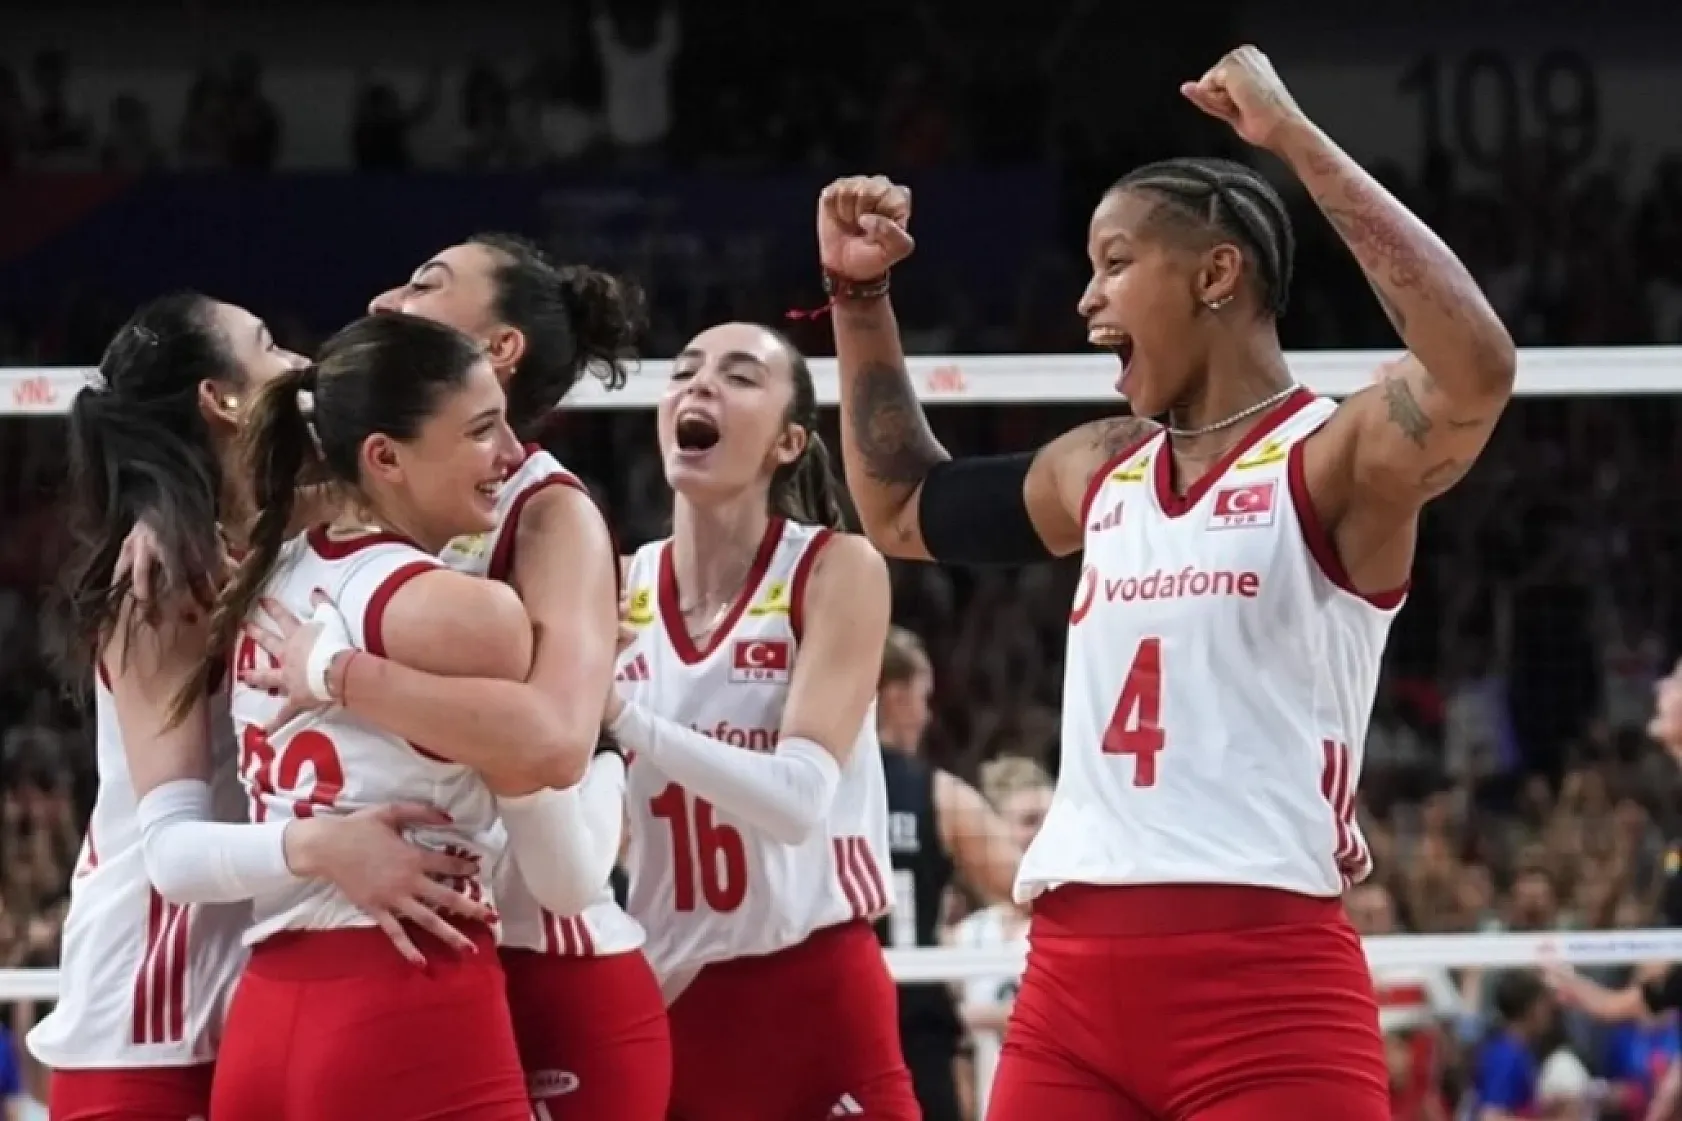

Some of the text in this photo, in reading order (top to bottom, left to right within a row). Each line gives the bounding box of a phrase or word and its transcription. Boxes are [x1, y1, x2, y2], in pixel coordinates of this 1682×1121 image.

[1398, 47, 1600, 172] 109
[1105, 566, 1260, 601] vodafone
[1102, 637, 1166, 787] 4
[649, 780, 748, 912] 16
